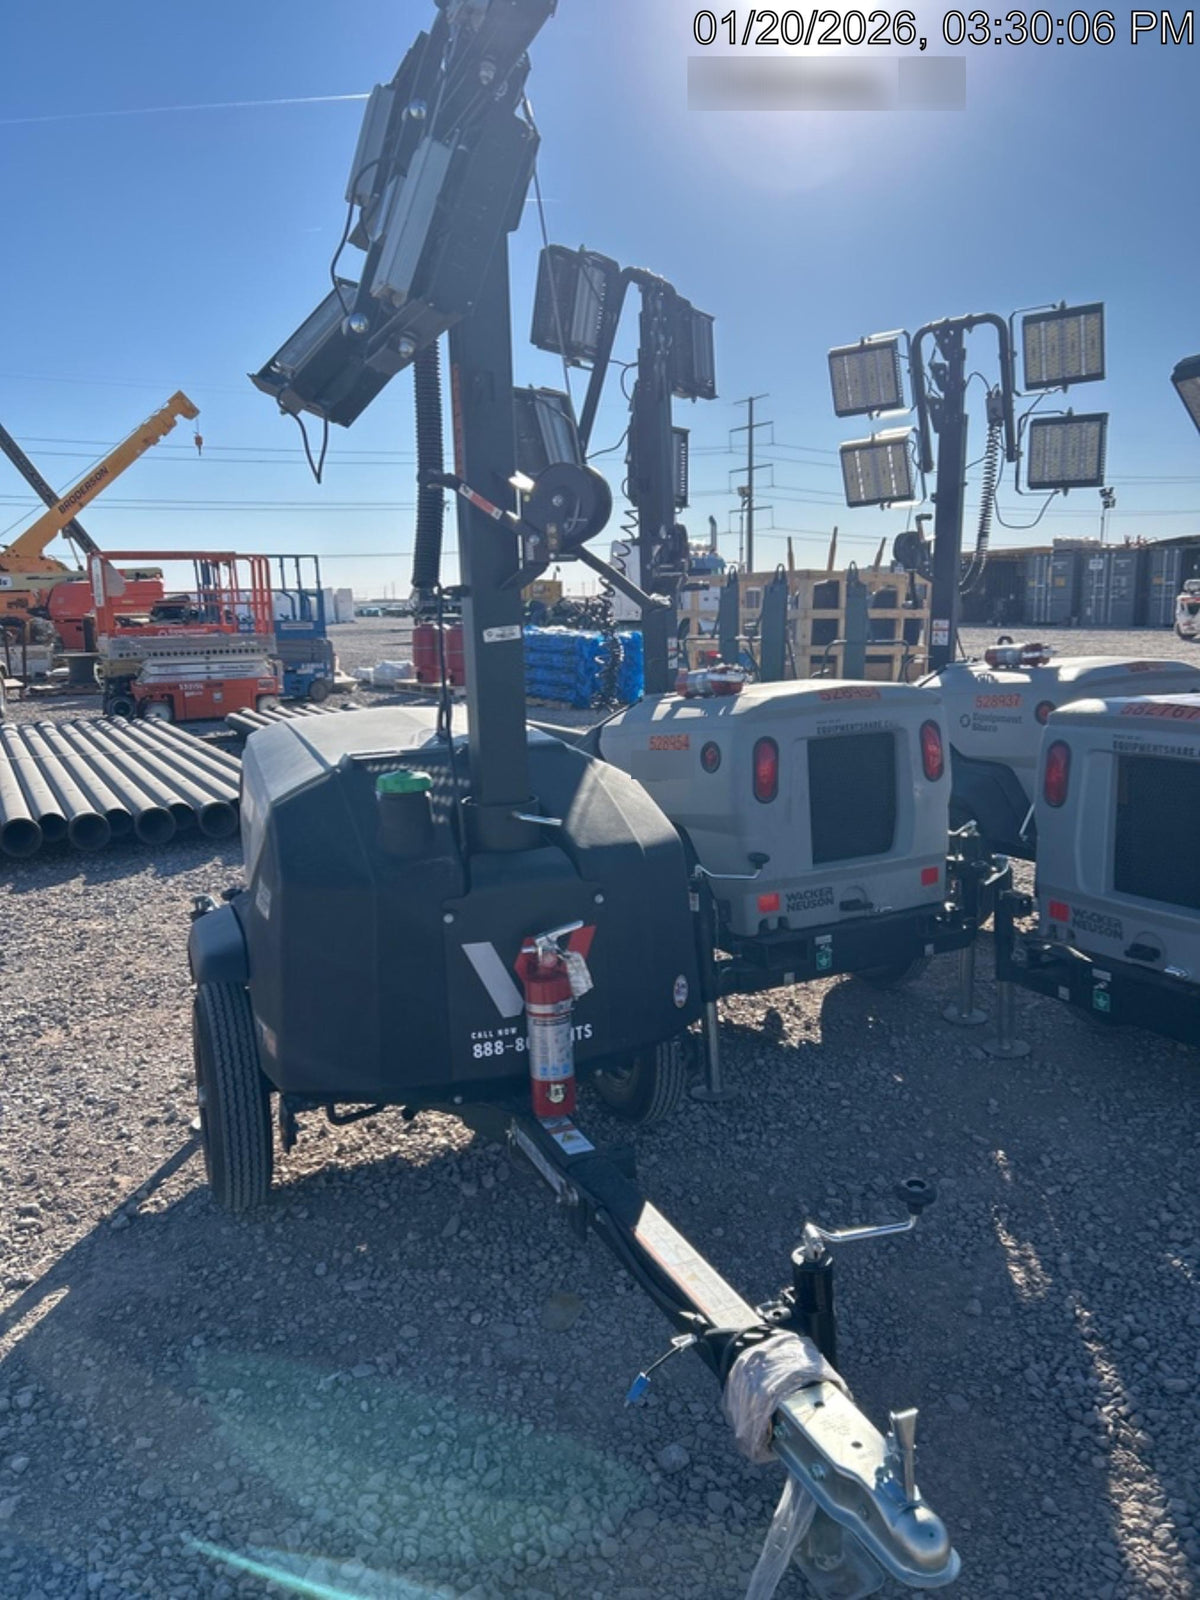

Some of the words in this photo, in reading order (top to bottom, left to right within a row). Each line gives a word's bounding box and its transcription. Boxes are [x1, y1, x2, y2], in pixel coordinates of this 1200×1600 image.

[58, 465, 109, 514] BRODERSON
[785, 886, 833, 902] WACKER
[786, 899, 835, 912] NEUSON
[471, 1030, 494, 1040] CALL
[497, 1027, 518, 1036] NOW
